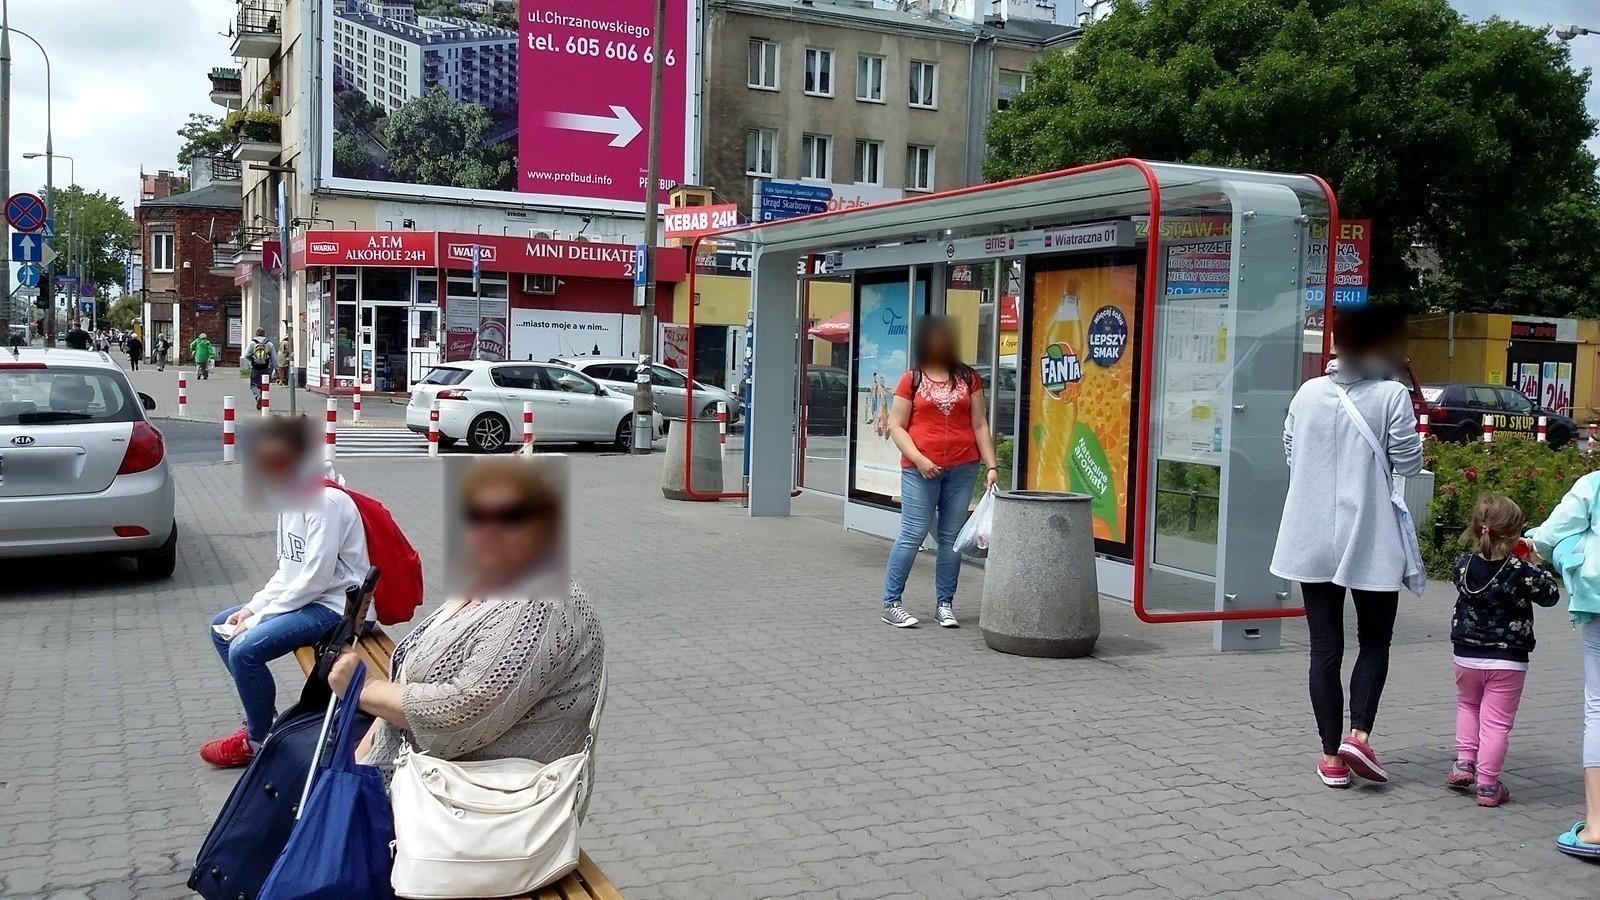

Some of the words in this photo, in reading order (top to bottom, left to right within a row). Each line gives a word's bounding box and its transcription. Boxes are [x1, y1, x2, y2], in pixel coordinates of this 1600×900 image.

[527, 10, 650, 39] ul.Chrzanowskiego
[527, 32, 560, 52] tel.
[565, 36, 600, 57] 605
[605, 41, 638, 61] 606
[643, 46, 676, 66] 66
[527, 169, 613, 186] www.profbud.info
[763, 197, 781, 209] Urząd
[782, 199, 811, 212] Skarbowy
[665, 212, 708, 232] KEBAB
[712, 210, 737, 228] 24H
[367, 236, 403, 249] A.T.M
[985, 238, 1006, 250] ams
[1055, 232, 1102, 246] Wiatraczna
[1104, 229, 1115, 242] 01
[313, 244, 336, 252] WARKA
[345, 250, 402, 261] ALKOHOLE
[404, 250, 426, 261] 24H
[453, 247, 492, 259] WAKA
[526, 243, 563, 258] MINI
[551, 322, 572, 330] moje
[1090, 334, 1126, 346] LEPSZY
[480, 340, 506, 357] ARKA
[1093, 347, 1119, 358] SMAK
[1041, 355, 1080, 384] FANTA
[1509, 415, 1534, 430] SKUP
[15, 436, 32, 444] KIA
[1074, 445, 1108, 495] aromaty
